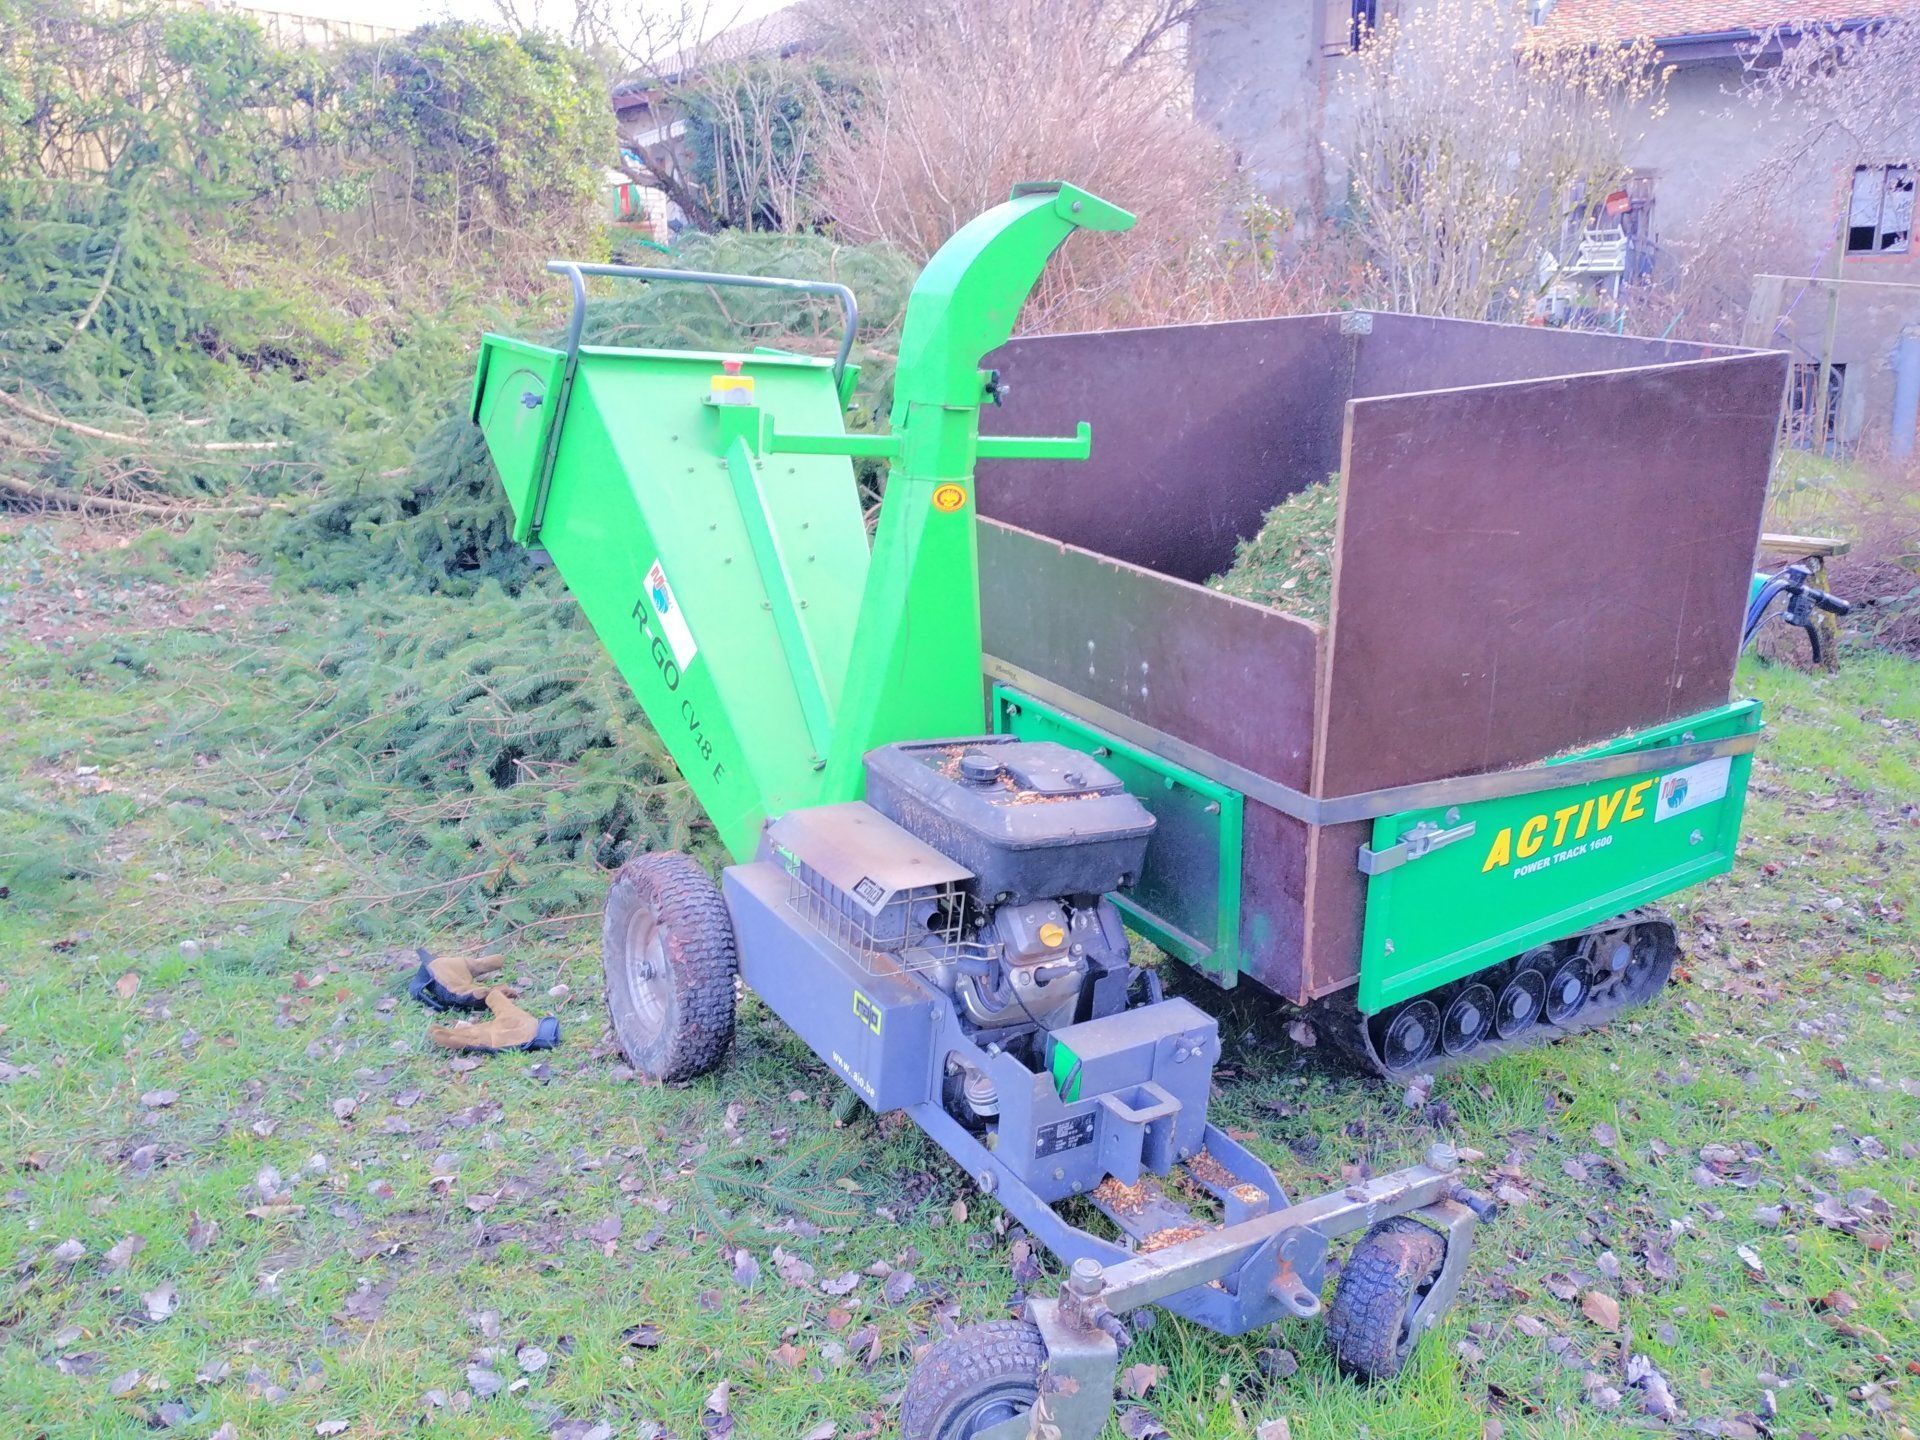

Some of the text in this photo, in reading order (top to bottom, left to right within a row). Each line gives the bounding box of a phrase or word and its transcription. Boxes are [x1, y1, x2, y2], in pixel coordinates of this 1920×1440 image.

[632, 599, 680, 692] R-GO
[712, 762, 726, 784] E
[1482, 778, 1654, 873] ACTIVE
[1513, 835, 1613, 879] POWER TRACK 1600
[832, 1049, 876, 1098] www.ajo.be
